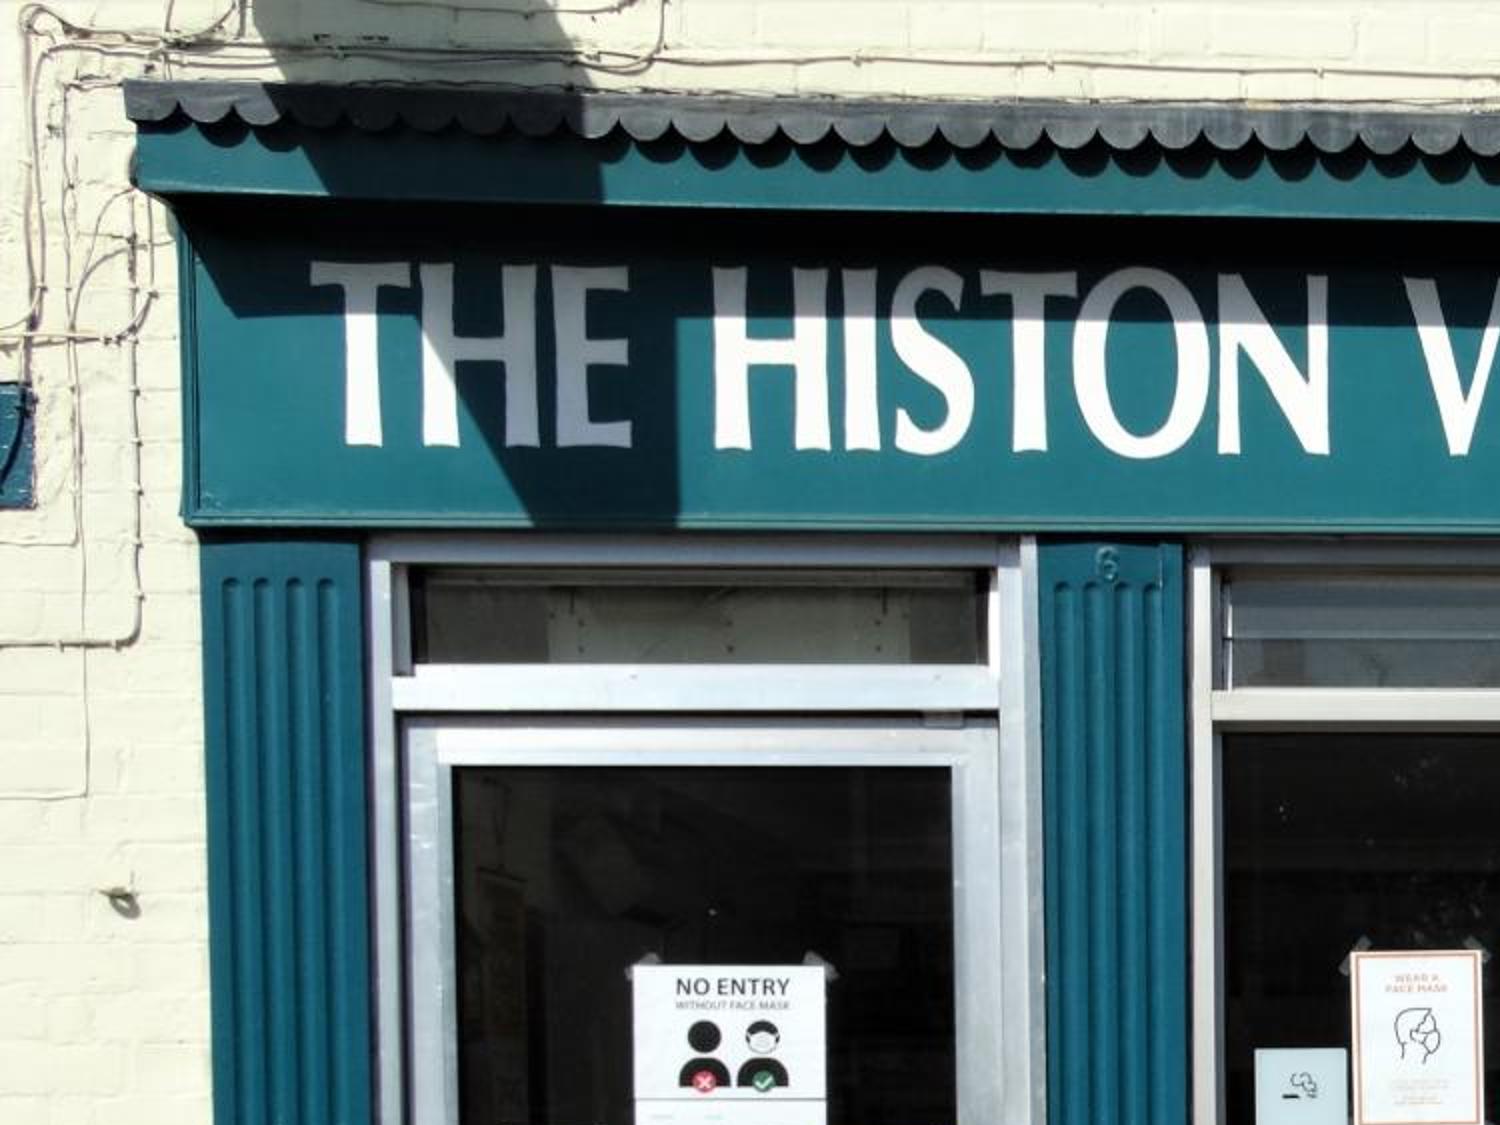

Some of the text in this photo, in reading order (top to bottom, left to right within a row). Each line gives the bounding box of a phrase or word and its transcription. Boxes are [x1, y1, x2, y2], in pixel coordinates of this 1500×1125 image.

[311, 261, 632, 449] THE
[712, 264, 1330, 460] HISTON
[676, 977, 791, 996] NO ENTRY
[676, 1001, 727, 1010] WITHOUT
